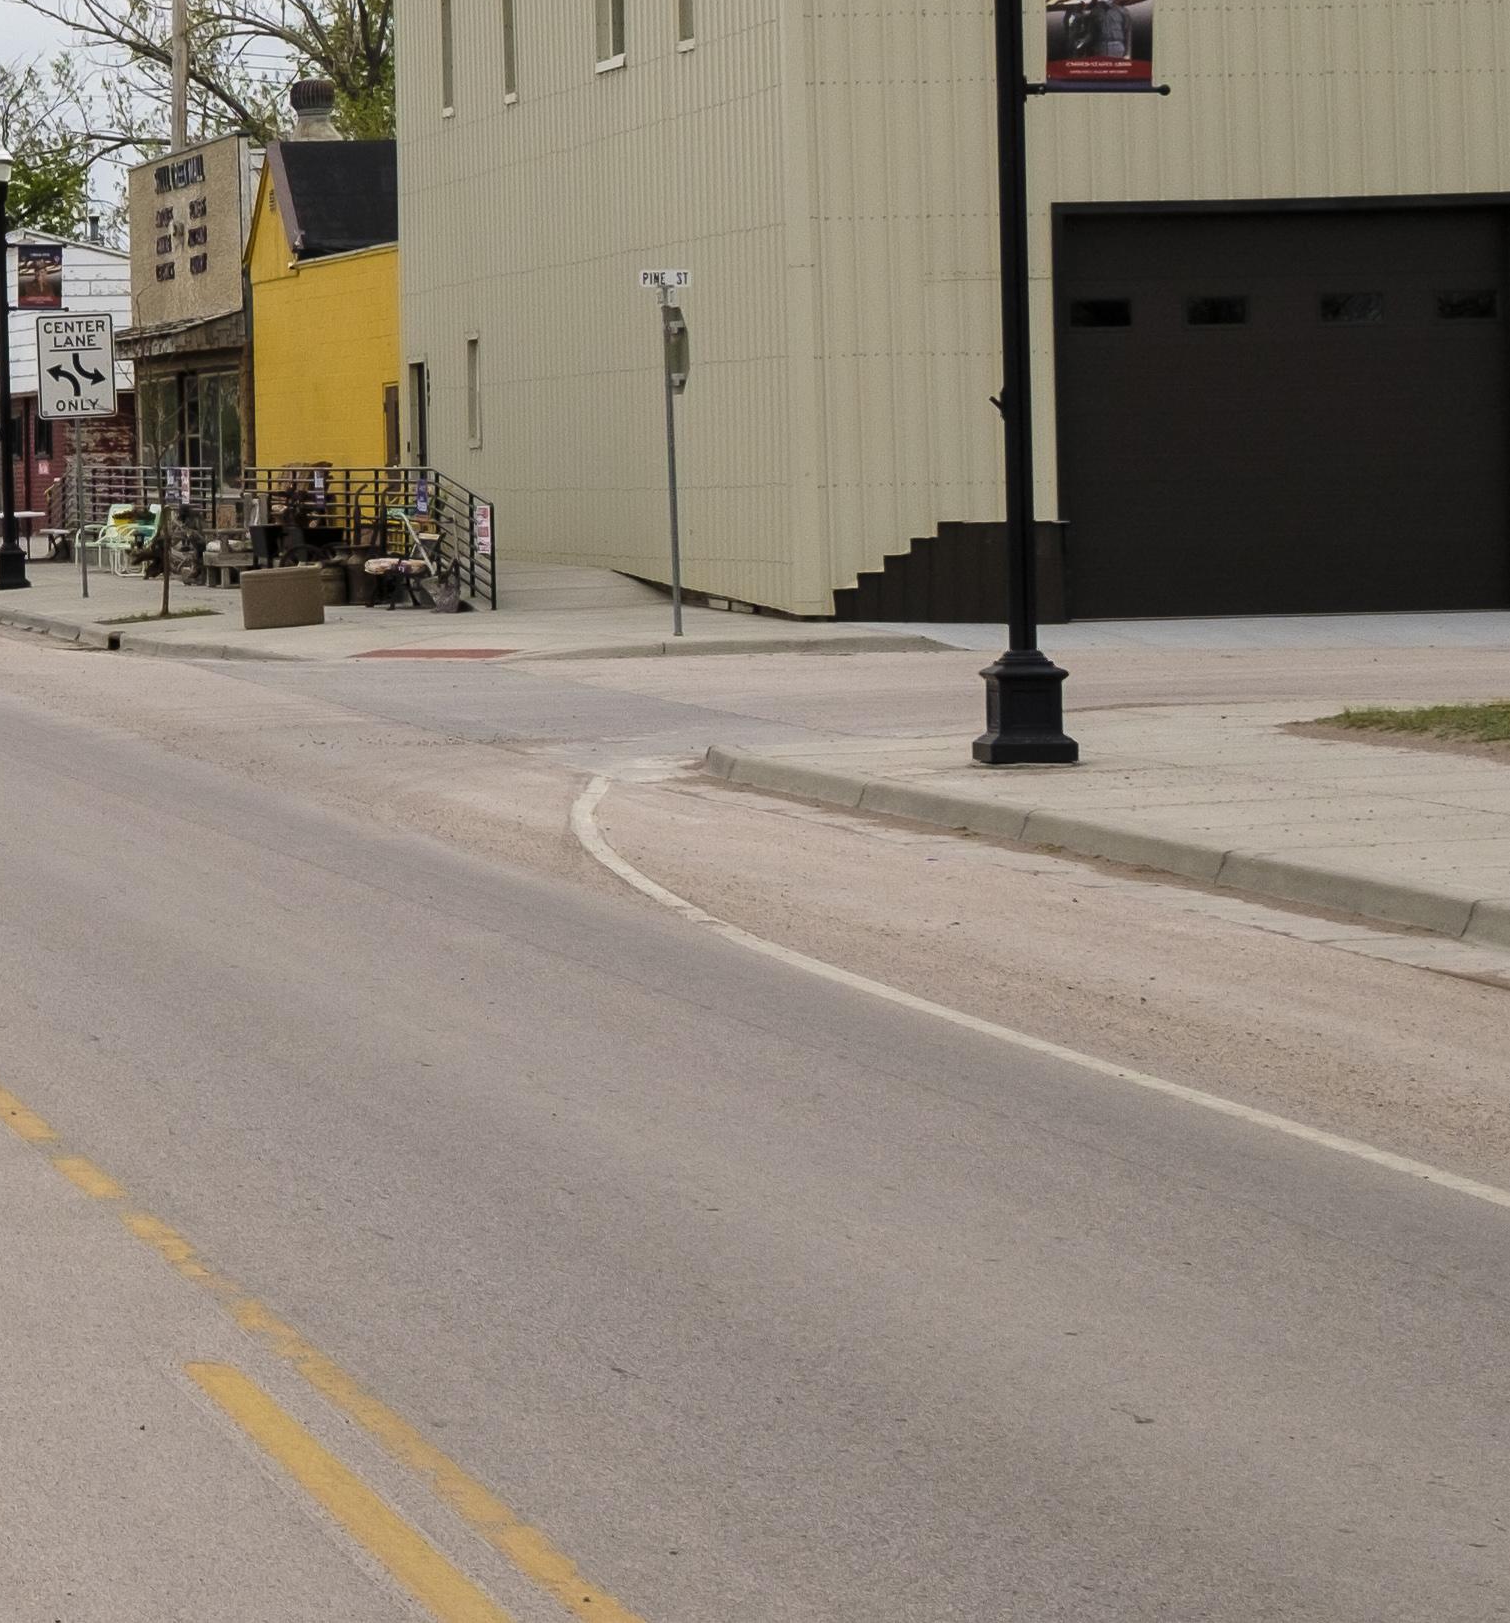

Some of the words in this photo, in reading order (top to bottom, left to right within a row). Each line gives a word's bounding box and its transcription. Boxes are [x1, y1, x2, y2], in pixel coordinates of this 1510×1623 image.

[642, 272, 666, 285] PINE
[676, 272, 689, 285] ST
[43, 320, 105, 334] CENTER
[53, 334, 96, 348] LANE
[55, 398, 99, 412] ONLY
